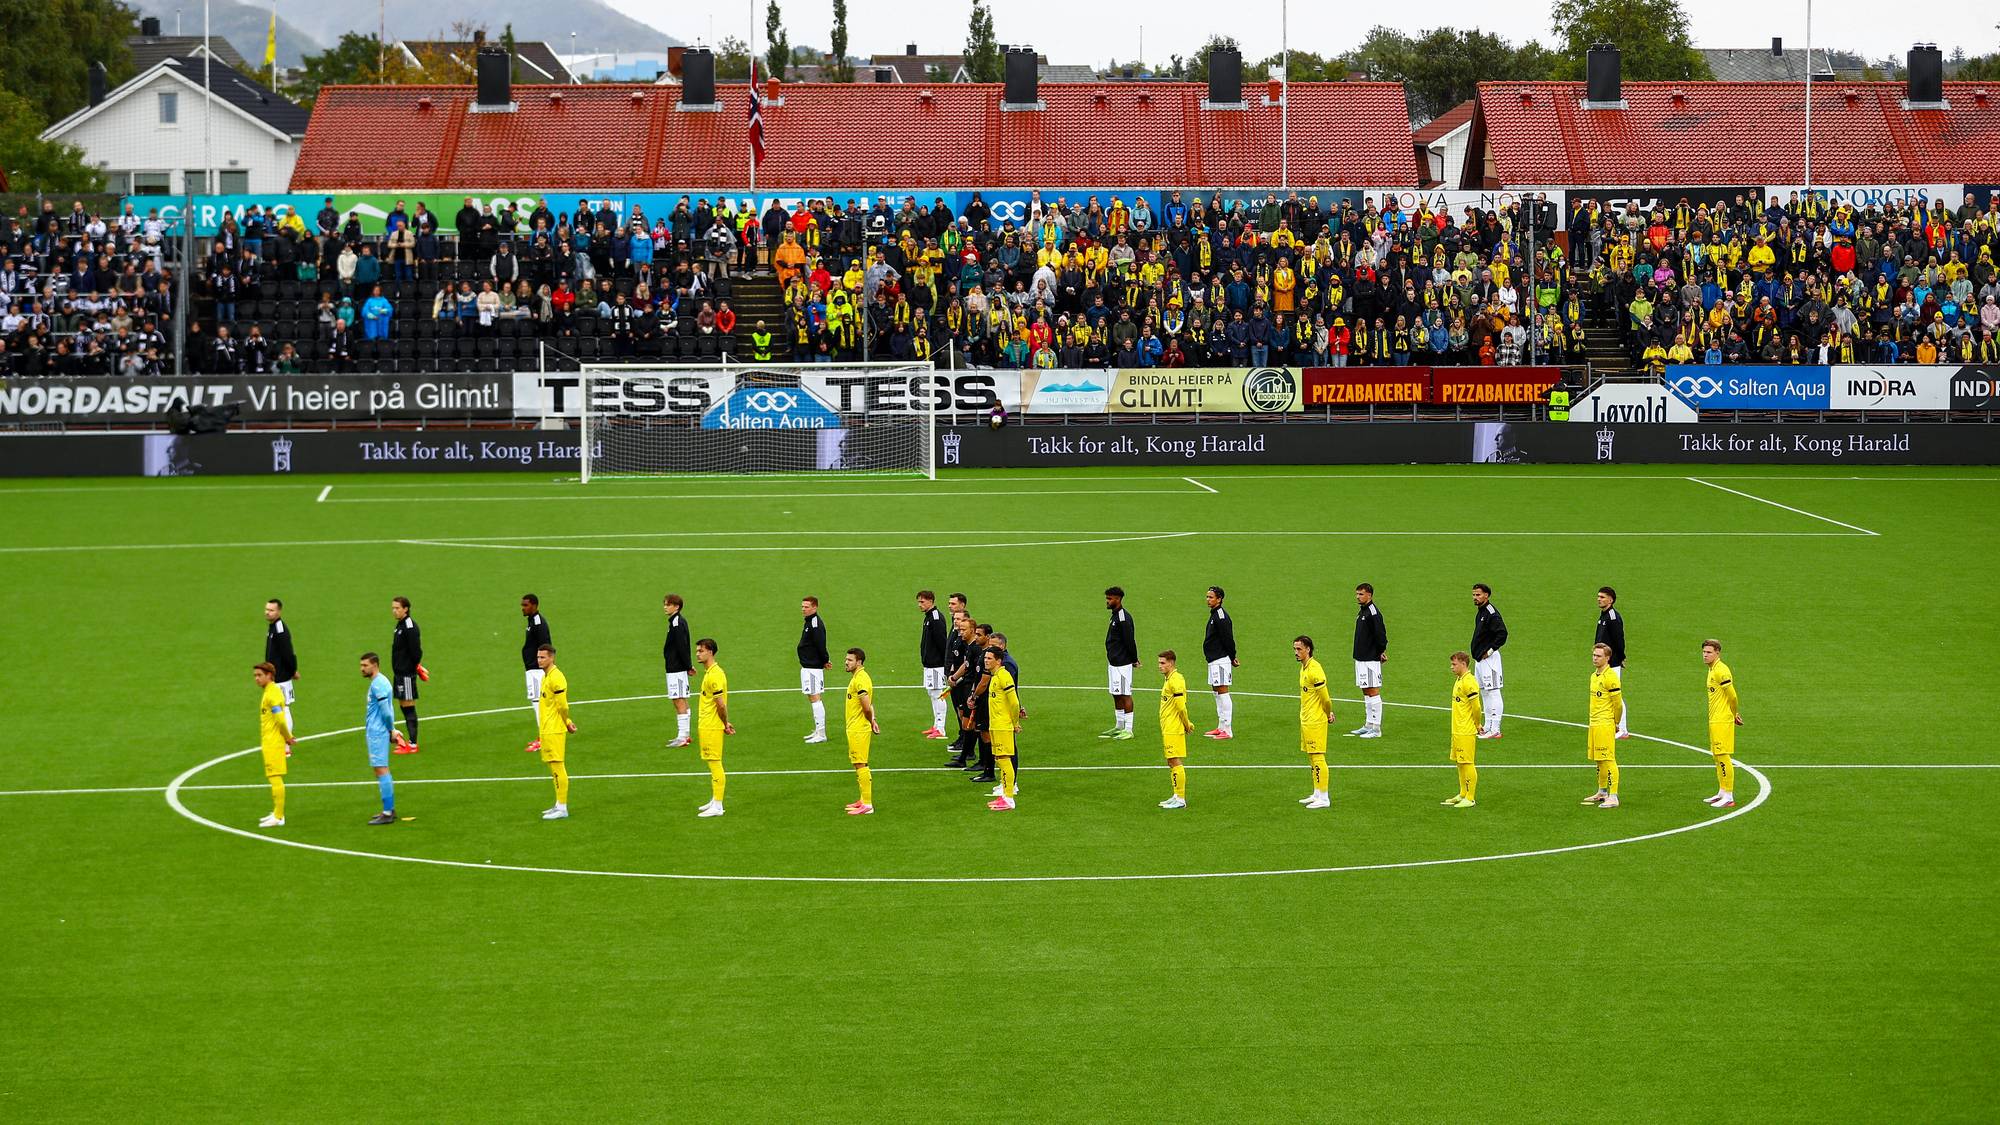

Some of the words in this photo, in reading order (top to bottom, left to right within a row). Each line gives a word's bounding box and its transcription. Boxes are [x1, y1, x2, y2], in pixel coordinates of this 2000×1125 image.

[1832, 188, 1929, 208] NORGES
[1129, 375, 1175, 385] BINDAL
[1178, 375, 1214, 385] HEIER
[1217, 372, 1232, 385] PÅ
[1728, 379, 1778, 396] Salten
[1782, 380, 1826, 400] Aqua
[1848, 380, 1916, 396] INDRA
[0, 386, 233, 415] NORDASFALT
[247, 385, 276, 411] Vi
[287, 384, 361, 410] heier
[370, 382, 404, 415] på
[415, 382, 500, 409] Glimt!
[538, 378, 711, 413] TESS
[825, 376, 997, 410] TESS
[1120, 388, 1203, 408] GLIMT!
[1312, 383, 1422, 403] PIZZABAKEREN
[1591, 396, 1667, 423] Løvold
[360, 442, 407, 460] Takk
[412, 441, 439, 460] for
[444, 441, 474, 462] alt,
[480, 442, 533, 465] Kong
[538, 441, 602, 459] Harad
[1028, 437, 1074, 454] Takk
[1079, 436, 1106, 454] for
[1111, 436, 1139, 456] alt,
[1146, 436, 1197, 459] Kong
[1201, 434, 1266, 452] Harald
[1679, 434, 1723, 451] Takk
[1728, 434, 1755, 451] for
[1760, 434, 1787, 454] alt,
[1793, 434, 1843, 457] Kong
[1848, 434, 1910, 452] Harald
